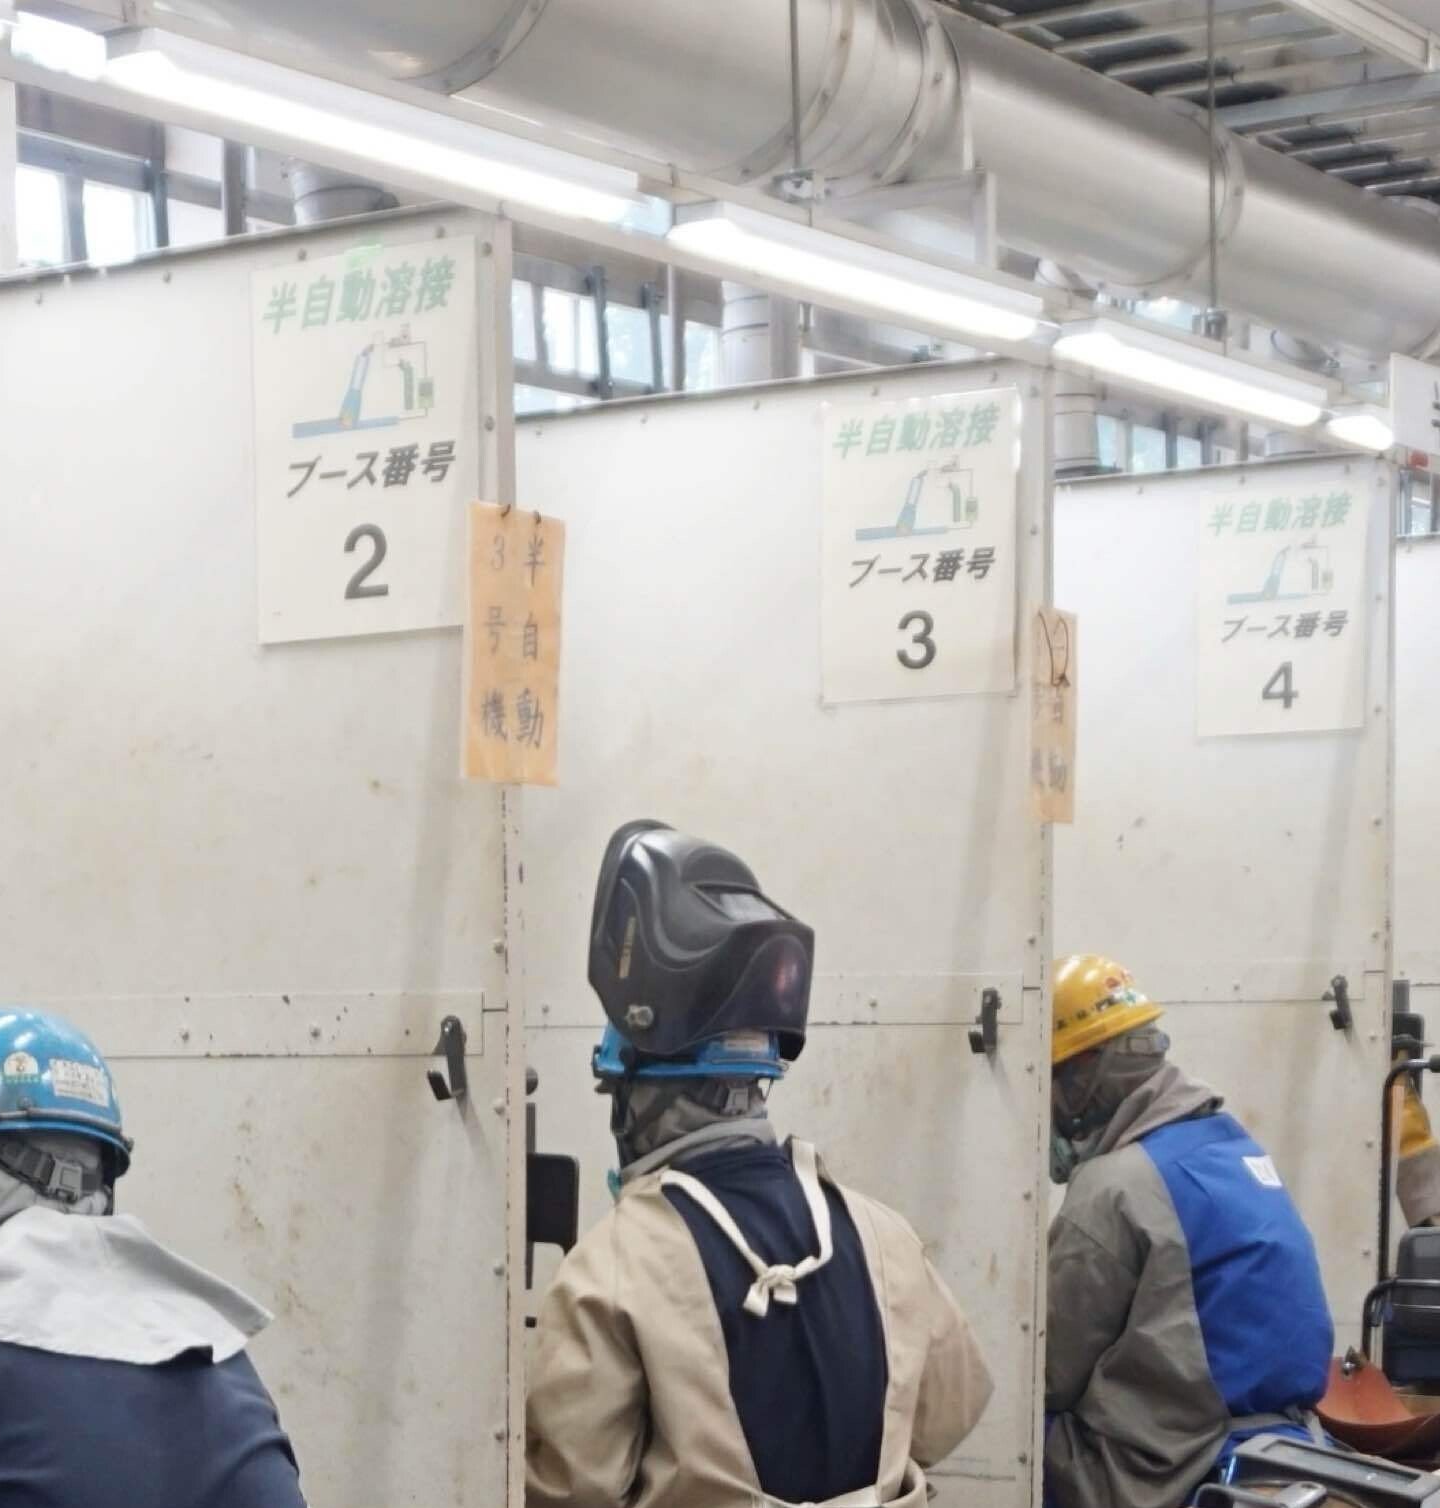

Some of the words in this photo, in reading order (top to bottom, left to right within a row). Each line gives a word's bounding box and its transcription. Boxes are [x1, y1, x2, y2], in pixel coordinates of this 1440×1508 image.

[264, 256, 456, 335] 半自動溶接
[832, 402, 1001, 459] 半自動溶接
[288, 441, 456, 499] ブース番号
[1208, 492, 1352, 537] 半自動溶接
[343, 523, 389, 600] 2
[849, 547, 995, 588] ブース番号
[481, 536, 508, 743] 3号機
[517, 535, 545, 748] 半自動
[897, 611, 937, 670] 3
[1221, 612, 1349, 643] ブース番号
[1262, 661, 1298, 710] 4
